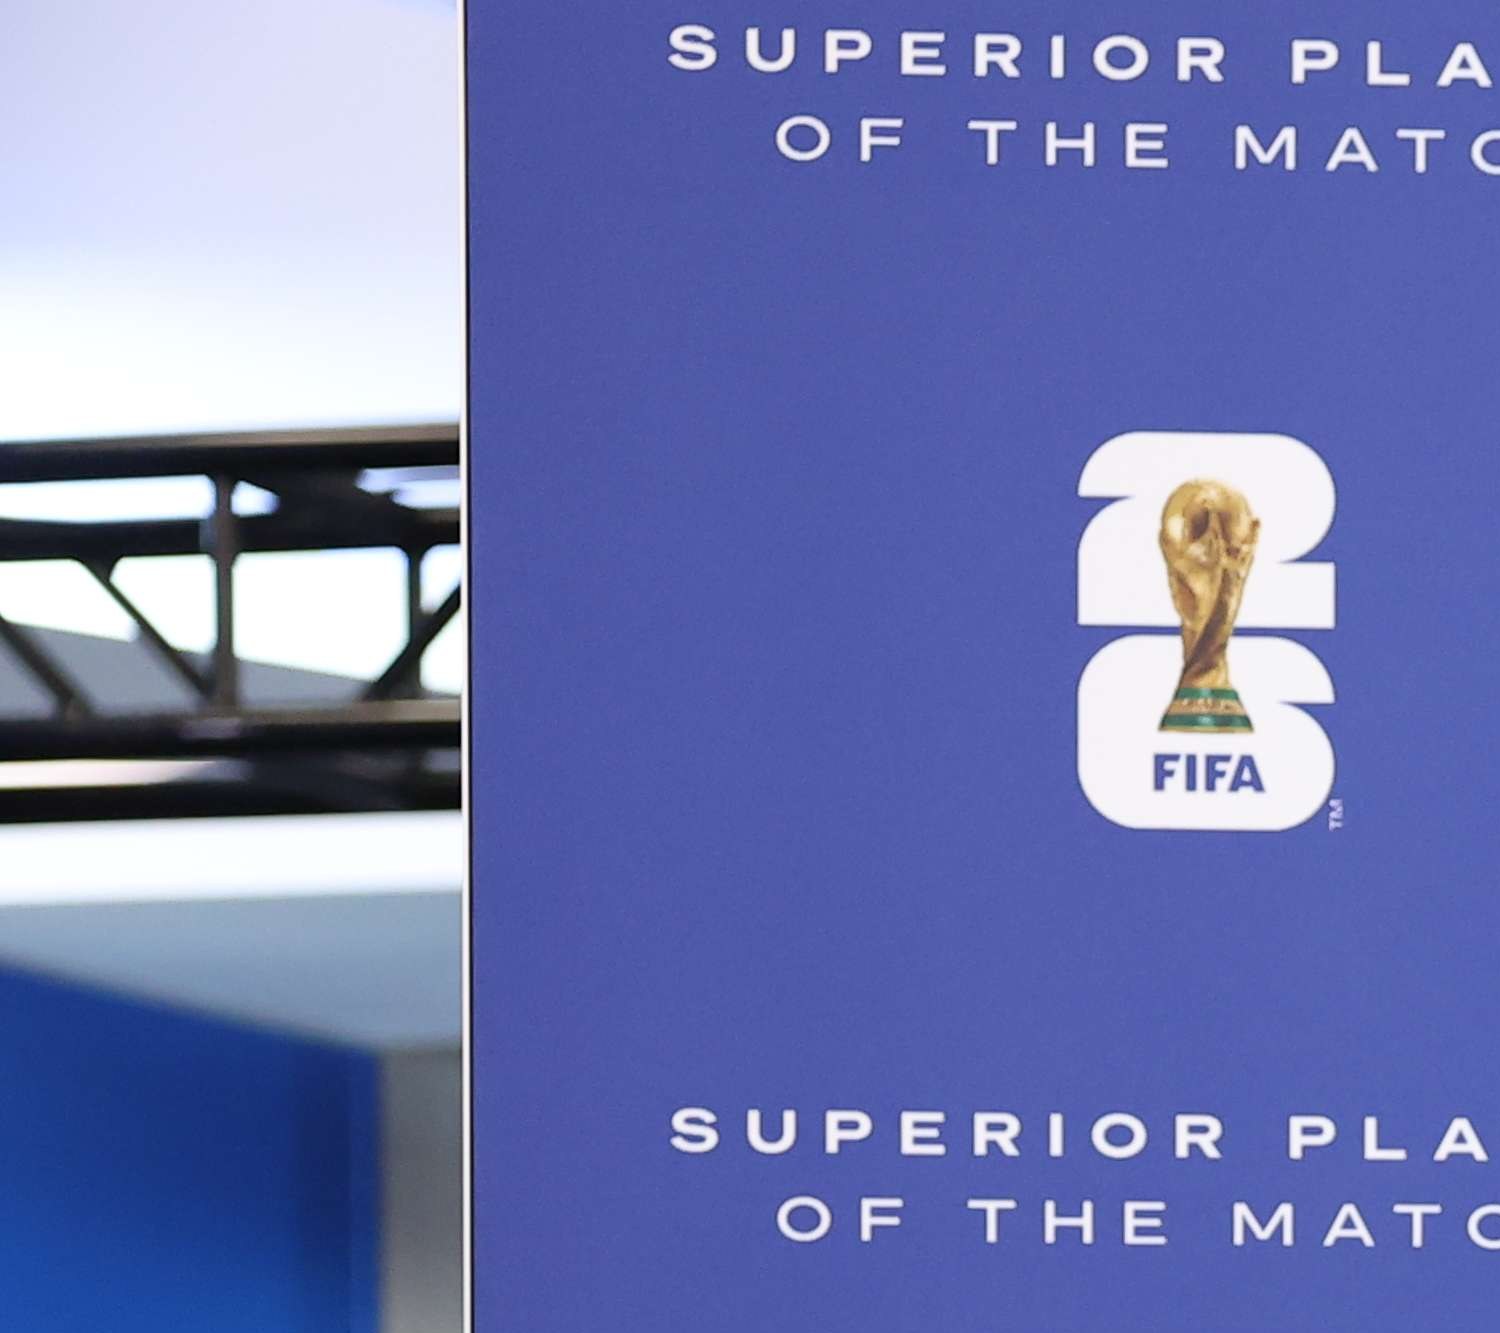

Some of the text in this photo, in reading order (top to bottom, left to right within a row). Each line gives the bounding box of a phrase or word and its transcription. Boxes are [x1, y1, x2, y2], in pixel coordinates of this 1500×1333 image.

[667, 24, 1226, 83] SUPERIOR
[775, 114, 904, 163] OF
[966, 119, 1170, 169] THE
[1153, 752, 1266, 793] FIFA
[669, 1106, 1223, 1160] SUPERIOR
[776, 1195, 905, 1243] OF
[966, 1198, 1168, 1246] THE
